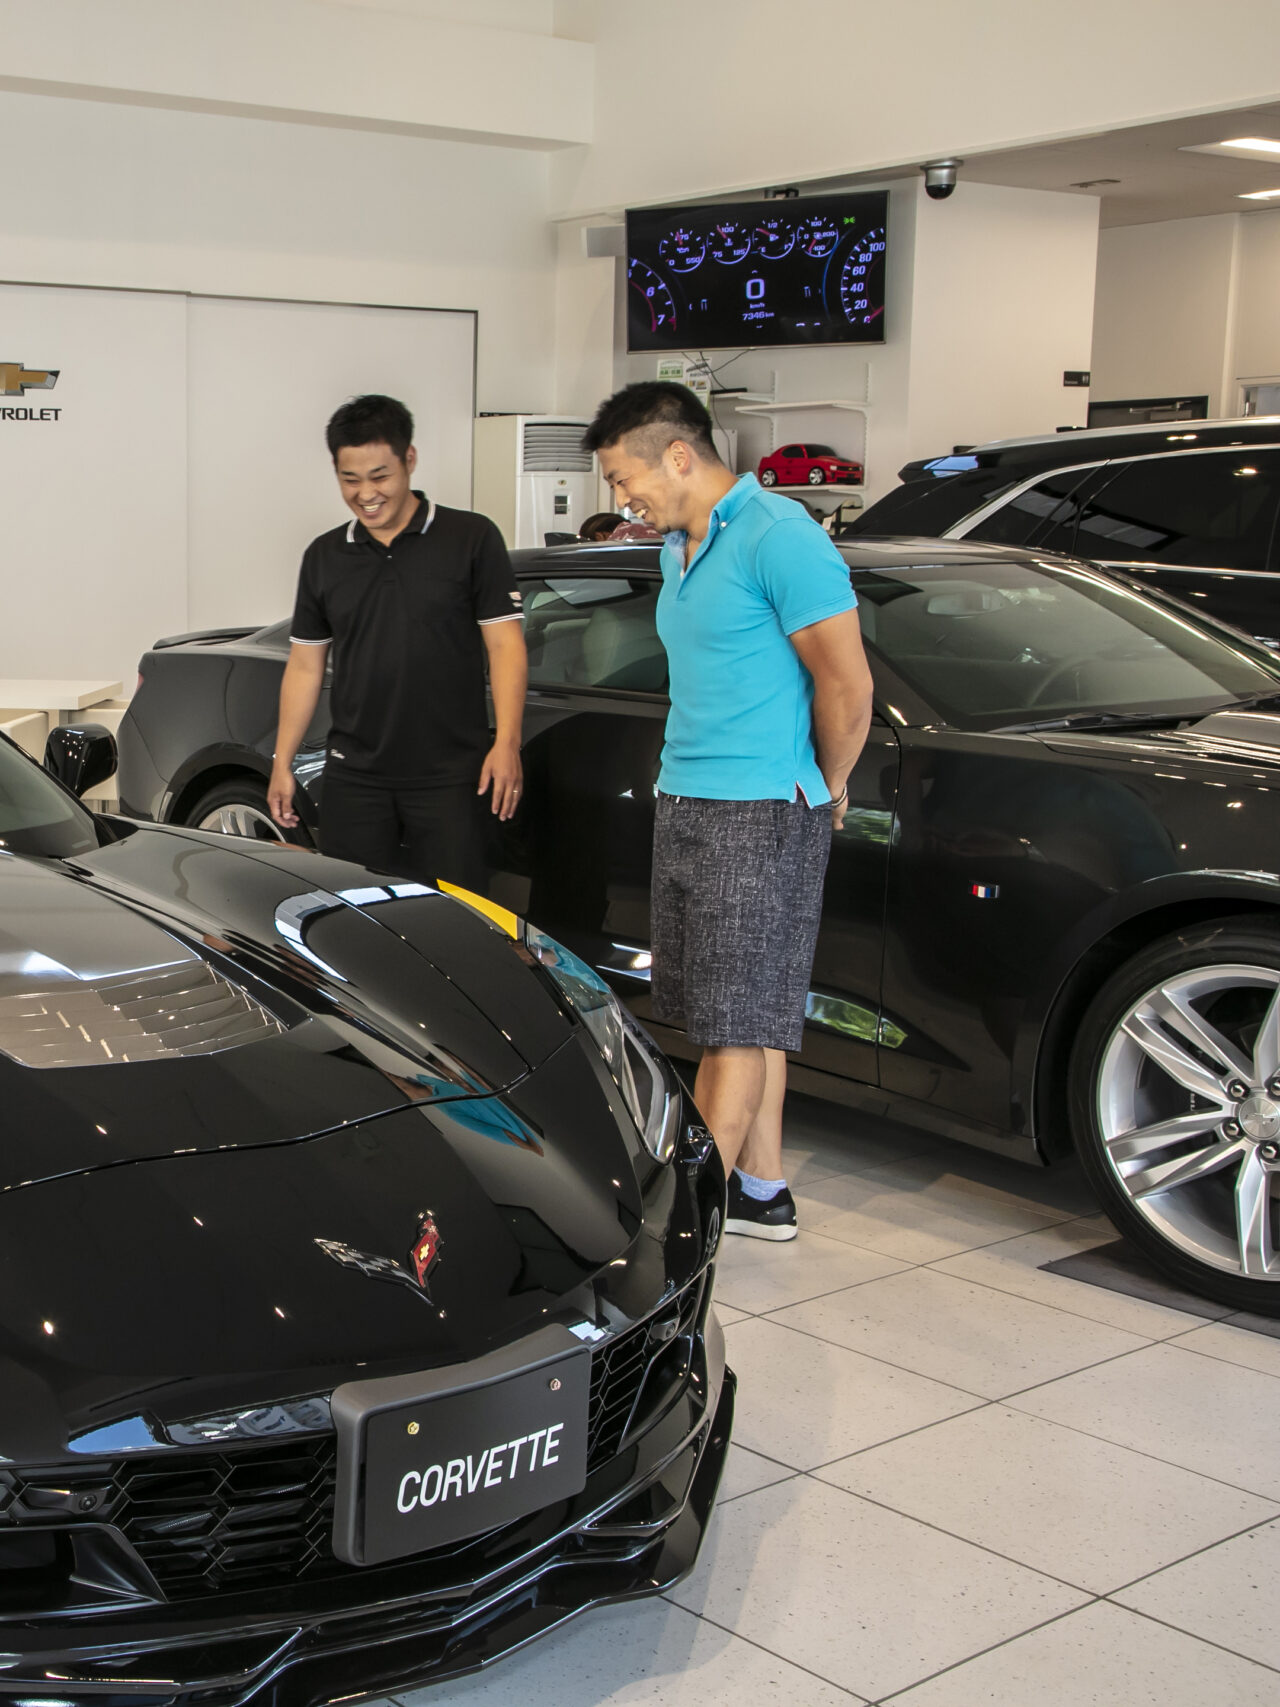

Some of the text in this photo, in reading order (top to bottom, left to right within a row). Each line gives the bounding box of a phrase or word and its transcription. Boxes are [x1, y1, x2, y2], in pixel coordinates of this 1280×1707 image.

[869, 242, 885, 252] 100
[859, 253, 872, 262] 80
[852, 265, 866, 276] 60
[745, 278, 765, 299] 0
[850, 282, 864, 293] 40
[854, 299, 868, 310] 20
[657, 314, 666, 325] 7
[397, 1423, 564, 1513] CORVETTE
